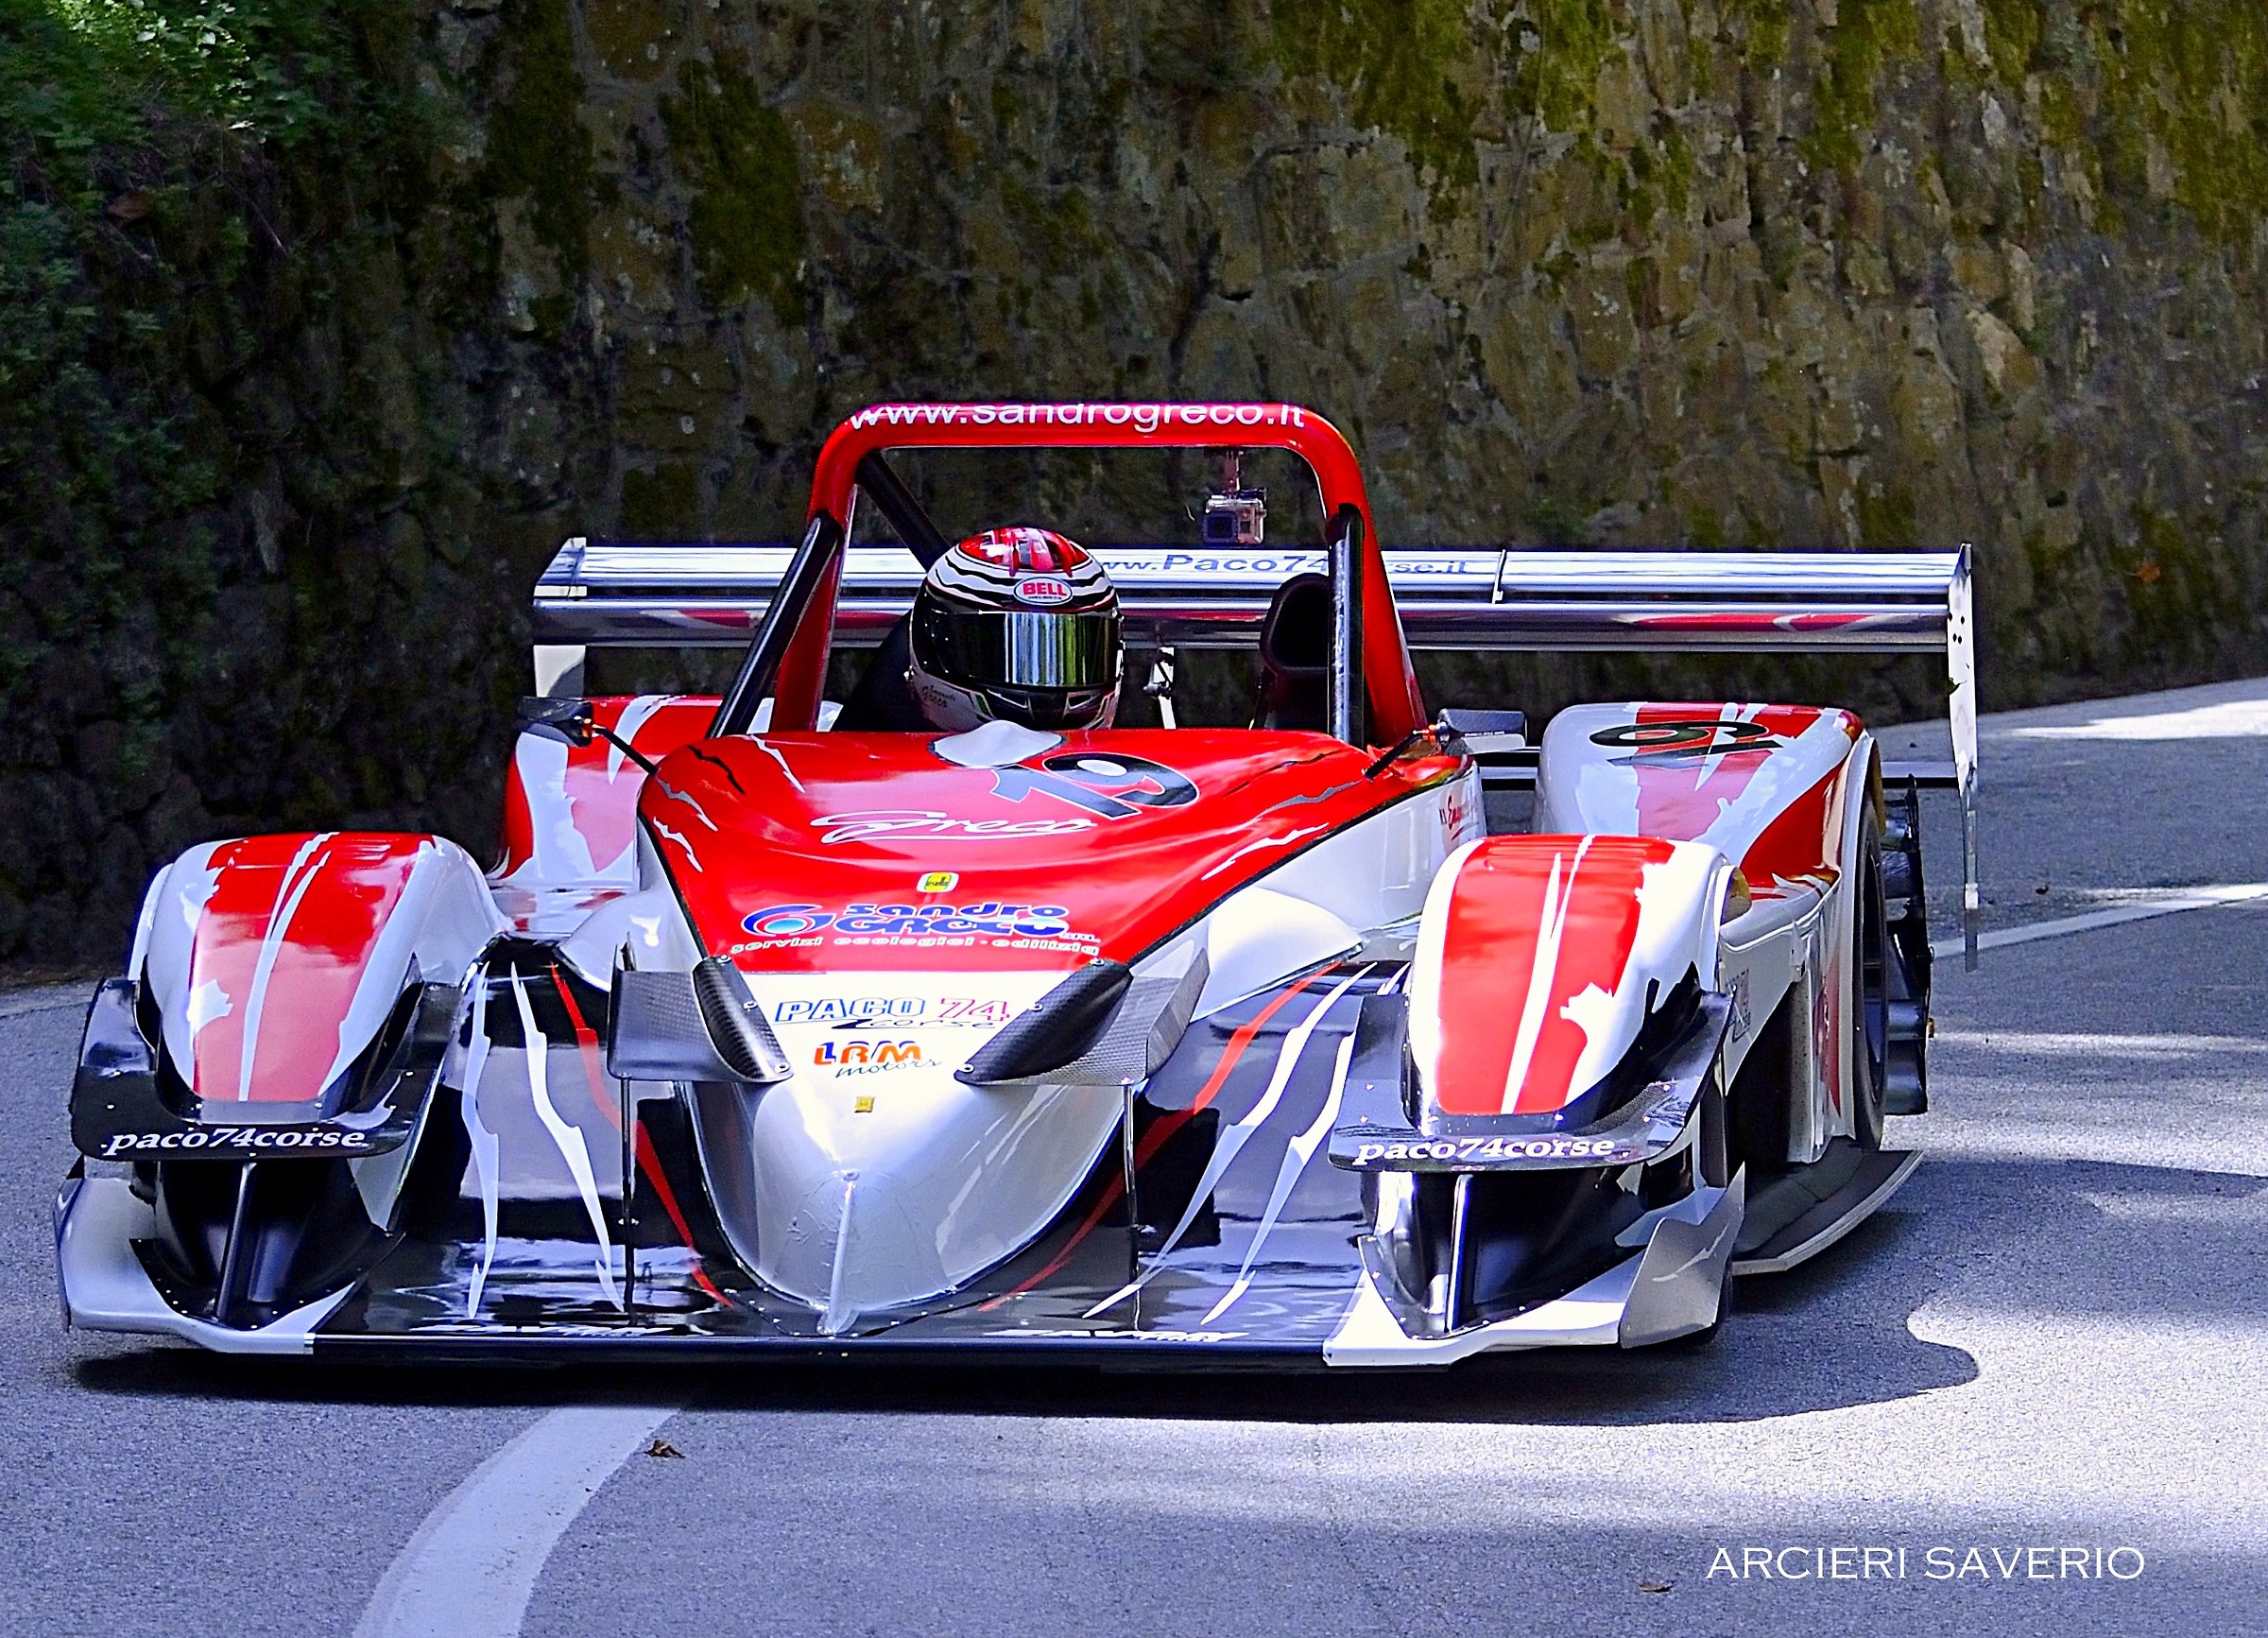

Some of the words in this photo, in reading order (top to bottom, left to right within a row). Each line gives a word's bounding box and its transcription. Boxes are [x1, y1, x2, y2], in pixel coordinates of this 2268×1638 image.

[850, 404, 1305, 432] www.sandrogreco.it
[1022, 581, 1067, 596] BELL
[989, 752, 1200, 819] 19
[810, 810, 1098, 845] Greco
[844, 903, 1069, 917] sandro
[731, 937, 823, 953] servizi
[833, 936, 975, 947] ecologici
[991, 939, 1100, 957] edilizia
[775, 997, 926, 1023] PACO
[938, 997, 1010, 1022] 74
[814, 1041, 921, 1065] LRM
[834, 1058, 943, 1078] motors
[103, 1127, 366, 1157] paco74corse
[1352, 1137, 1615, 1166] paco74corse
